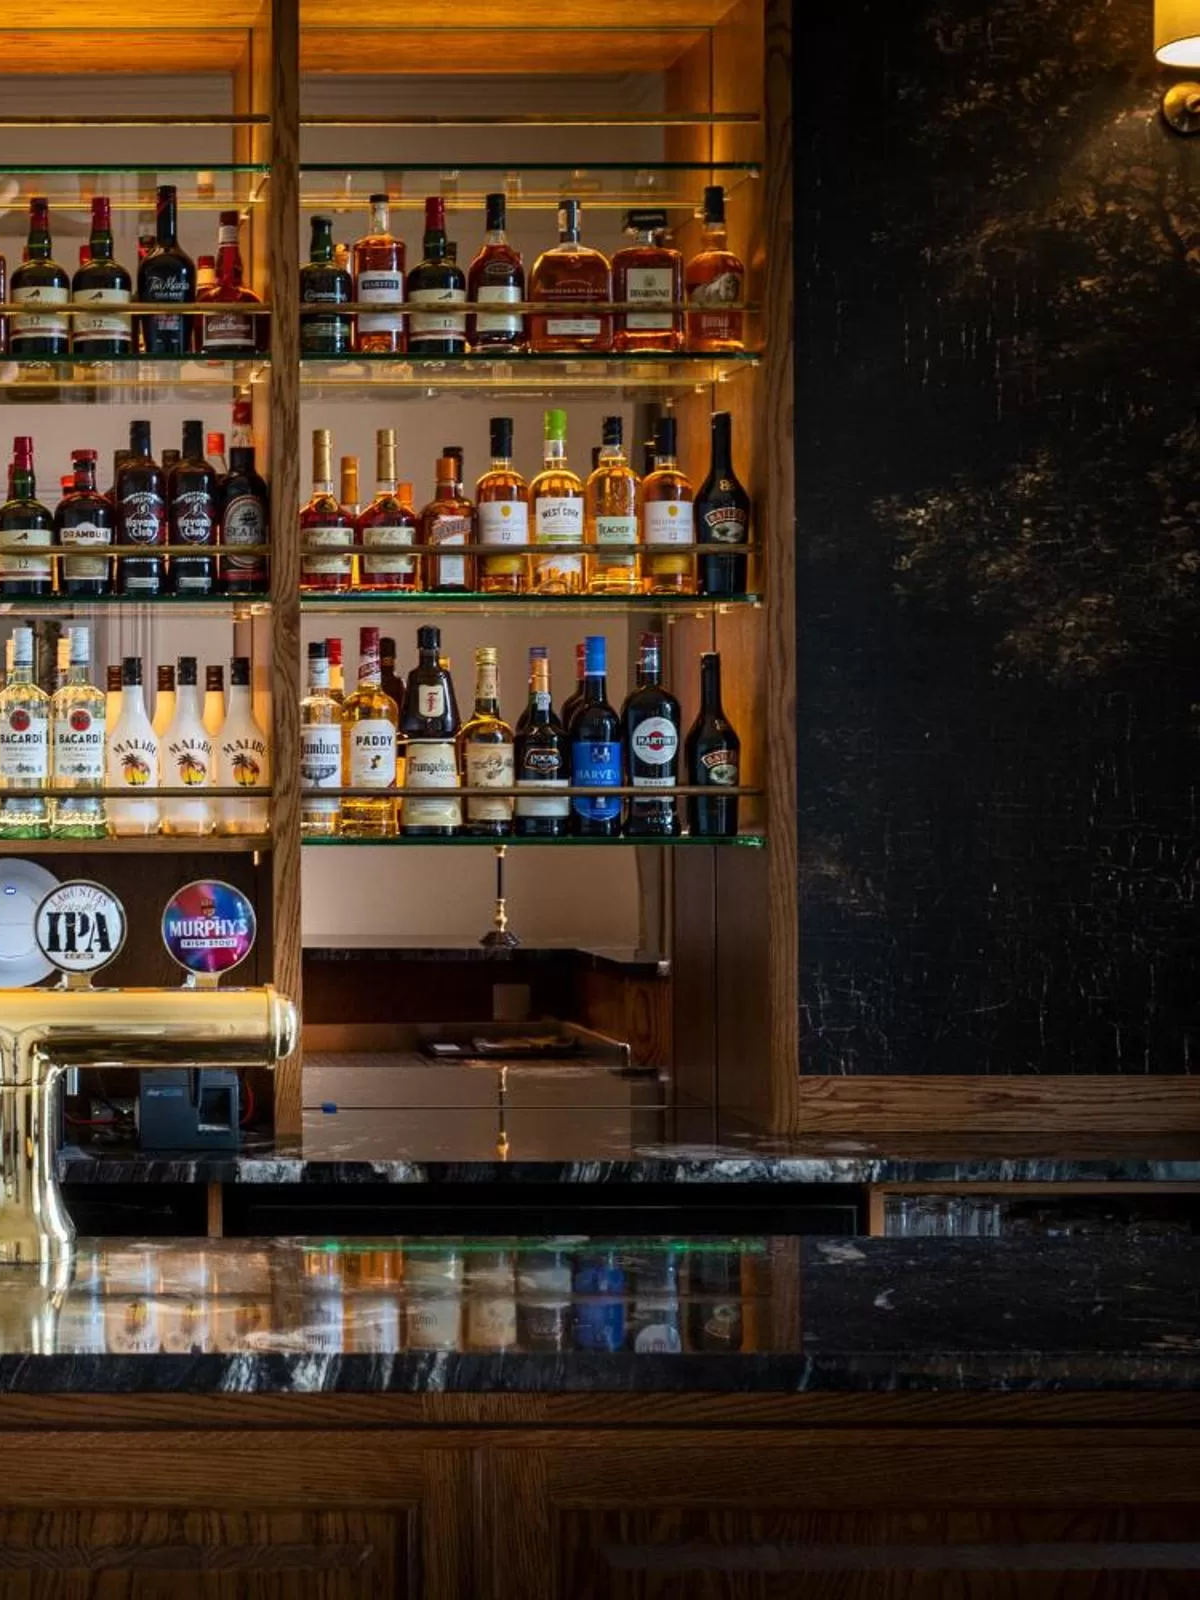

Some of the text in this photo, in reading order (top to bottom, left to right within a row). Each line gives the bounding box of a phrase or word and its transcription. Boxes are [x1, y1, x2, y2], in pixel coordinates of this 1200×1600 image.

[92, 319, 103, 327] 12
[541, 510, 561, 519] WEST
[63, 530, 110, 538] DRAMBUIE
[132, 527, 153, 537] Club
[184, 527, 206, 537] Club
[17, 559, 29, 568] 12
[356, 735, 393, 746] PADDY
[636, 736, 675, 746] MARTINI
[46, 911, 113, 953] IPA
[183, 939, 235, 947] IRISH STOUT
